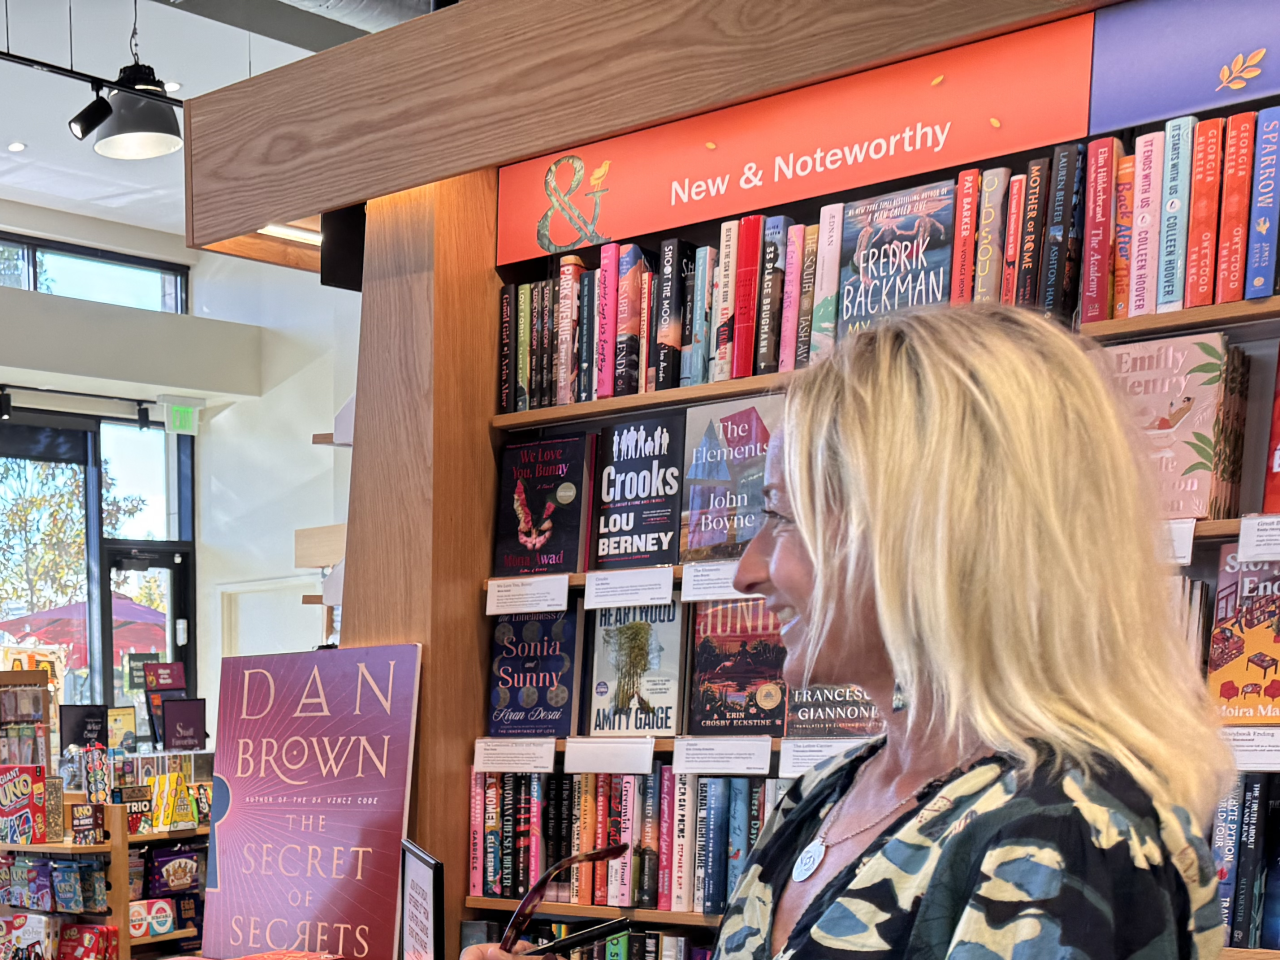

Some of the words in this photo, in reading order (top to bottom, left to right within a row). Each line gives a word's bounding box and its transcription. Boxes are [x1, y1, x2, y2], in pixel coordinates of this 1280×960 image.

[1144, 139, 1154, 147] IT
[1171, 124, 1181, 132] IT
[670, 172, 730, 206] New
[738, 162, 764, 190] &
[773, 120, 952, 184] Noteworthy
[1098, 147, 1109, 166] Elin
[1142, 149, 1153, 171] ENDS
[1170, 133, 1180, 162] STARTS
[1195, 136, 1205, 180] HUNTER
[1206, 129, 1217, 183] GEORGIA
[1227, 129, 1237, 175] HUNTER
[1237, 123, 1249, 177] GEORGIA
[1058, 152, 1069, 189] LAUREN
[1169, 163, 1179, 183] WITH
[1257, 120, 1279, 208] SPARROW
[964, 176, 974, 194] PAT
[1028, 165, 1041, 219] MOTHER
[1095, 167, 1108, 223] Hilderbrand
[1141, 173, 1151, 195] WITH
[1168, 184, 1178, 196] US
[960, 197, 972, 237] BARKER
[1053, 191, 1065, 223] BELFER
[1140, 197, 1150, 209] US
[807, 234, 817, 252] THE
[1027, 222, 1035, 233] OF
[1091, 227, 1103, 249] The
[1165, 215, 1178, 255] COLLEEN
[1201, 232, 1211, 254] ONE
[1232, 227, 1242, 250] ONE
[766, 246, 775, 258] 33
[859, 237, 931, 281] FREDRIK
[1022, 235, 1036, 270] ROME
[1135, 230, 1149, 266] COLLEEN
[1219, 242, 1230, 279] THING
[763, 262, 773, 295] PLACE
[803, 253, 815, 292] SOUTH
[1085, 251, 1102, 297] Academy
[1162, 257, 1175, 298] HOOVER
[1188, 246, 1198, 283] THING
[1198, 256, 1209, 293] GOOD
[1229, 252, 1240, 289] GOOD
[560, 266, 572, 301] PARK
[843, 267, 944, 321] BACKMAN
[1133, 268, 1147, 311] HOOVER
[558, 301, 571, 342] AVENUE
[759, 298, 771, 354] BRUGMANN
[716, 420, 749, 439] The
[691, 440, 770, 466] Elements
[601, 460, 679, 503] Crooks
[708, 491, 749, 510] John
[599, 512, 635, 534] LOU
[701, 512, 756, 534] Boyne
[597, 531, 675, 556] BERNEY
[599, 600, 676, 627] HEARTWOOD
[502, 636, 561, 657] Sonia
[240, 660, 396, 720] DAN
[498, 666, 563, 691] Sunny
[492, 707, 526, 724] Kiran
[527, 707, 563, 722] Desai
[594, 707, 633, 731] AMITY
[634, 706, 673, 731] GAIGE
[701, 719, 731, 727] CROSBY
[733, 719, 771, 727] ECKSTINE
[235, 735, 391, 785] BROWN
[245, 796, 273, 804] AUTHOR
[278, 796, 288, 804] OF
[327, 796, 352, 804] VINCI
[699, 783, 708, 814] BANAL
[1253, 784, 1261, 797] THE
[73, 804, 93, 818] UNO
[126, 801, 150, 813] TRIO
[485, 787, 497, 827] WOMEN
[621, 781, 631, 834] Greenwich
[1251, 799, 1260, 825] TRUTH
[285, 814, 326, 832] THE
[503, 816, 513, 855] CHELSEA
[1247, 825, 1258, 850] ABOUT
[696, 816, 707, 871] NIGHTMARE
[242, 843, 372, 880] SECRET
[502, 854, 513, 887] BIEKER
[288, 889, 312, 907] OF
